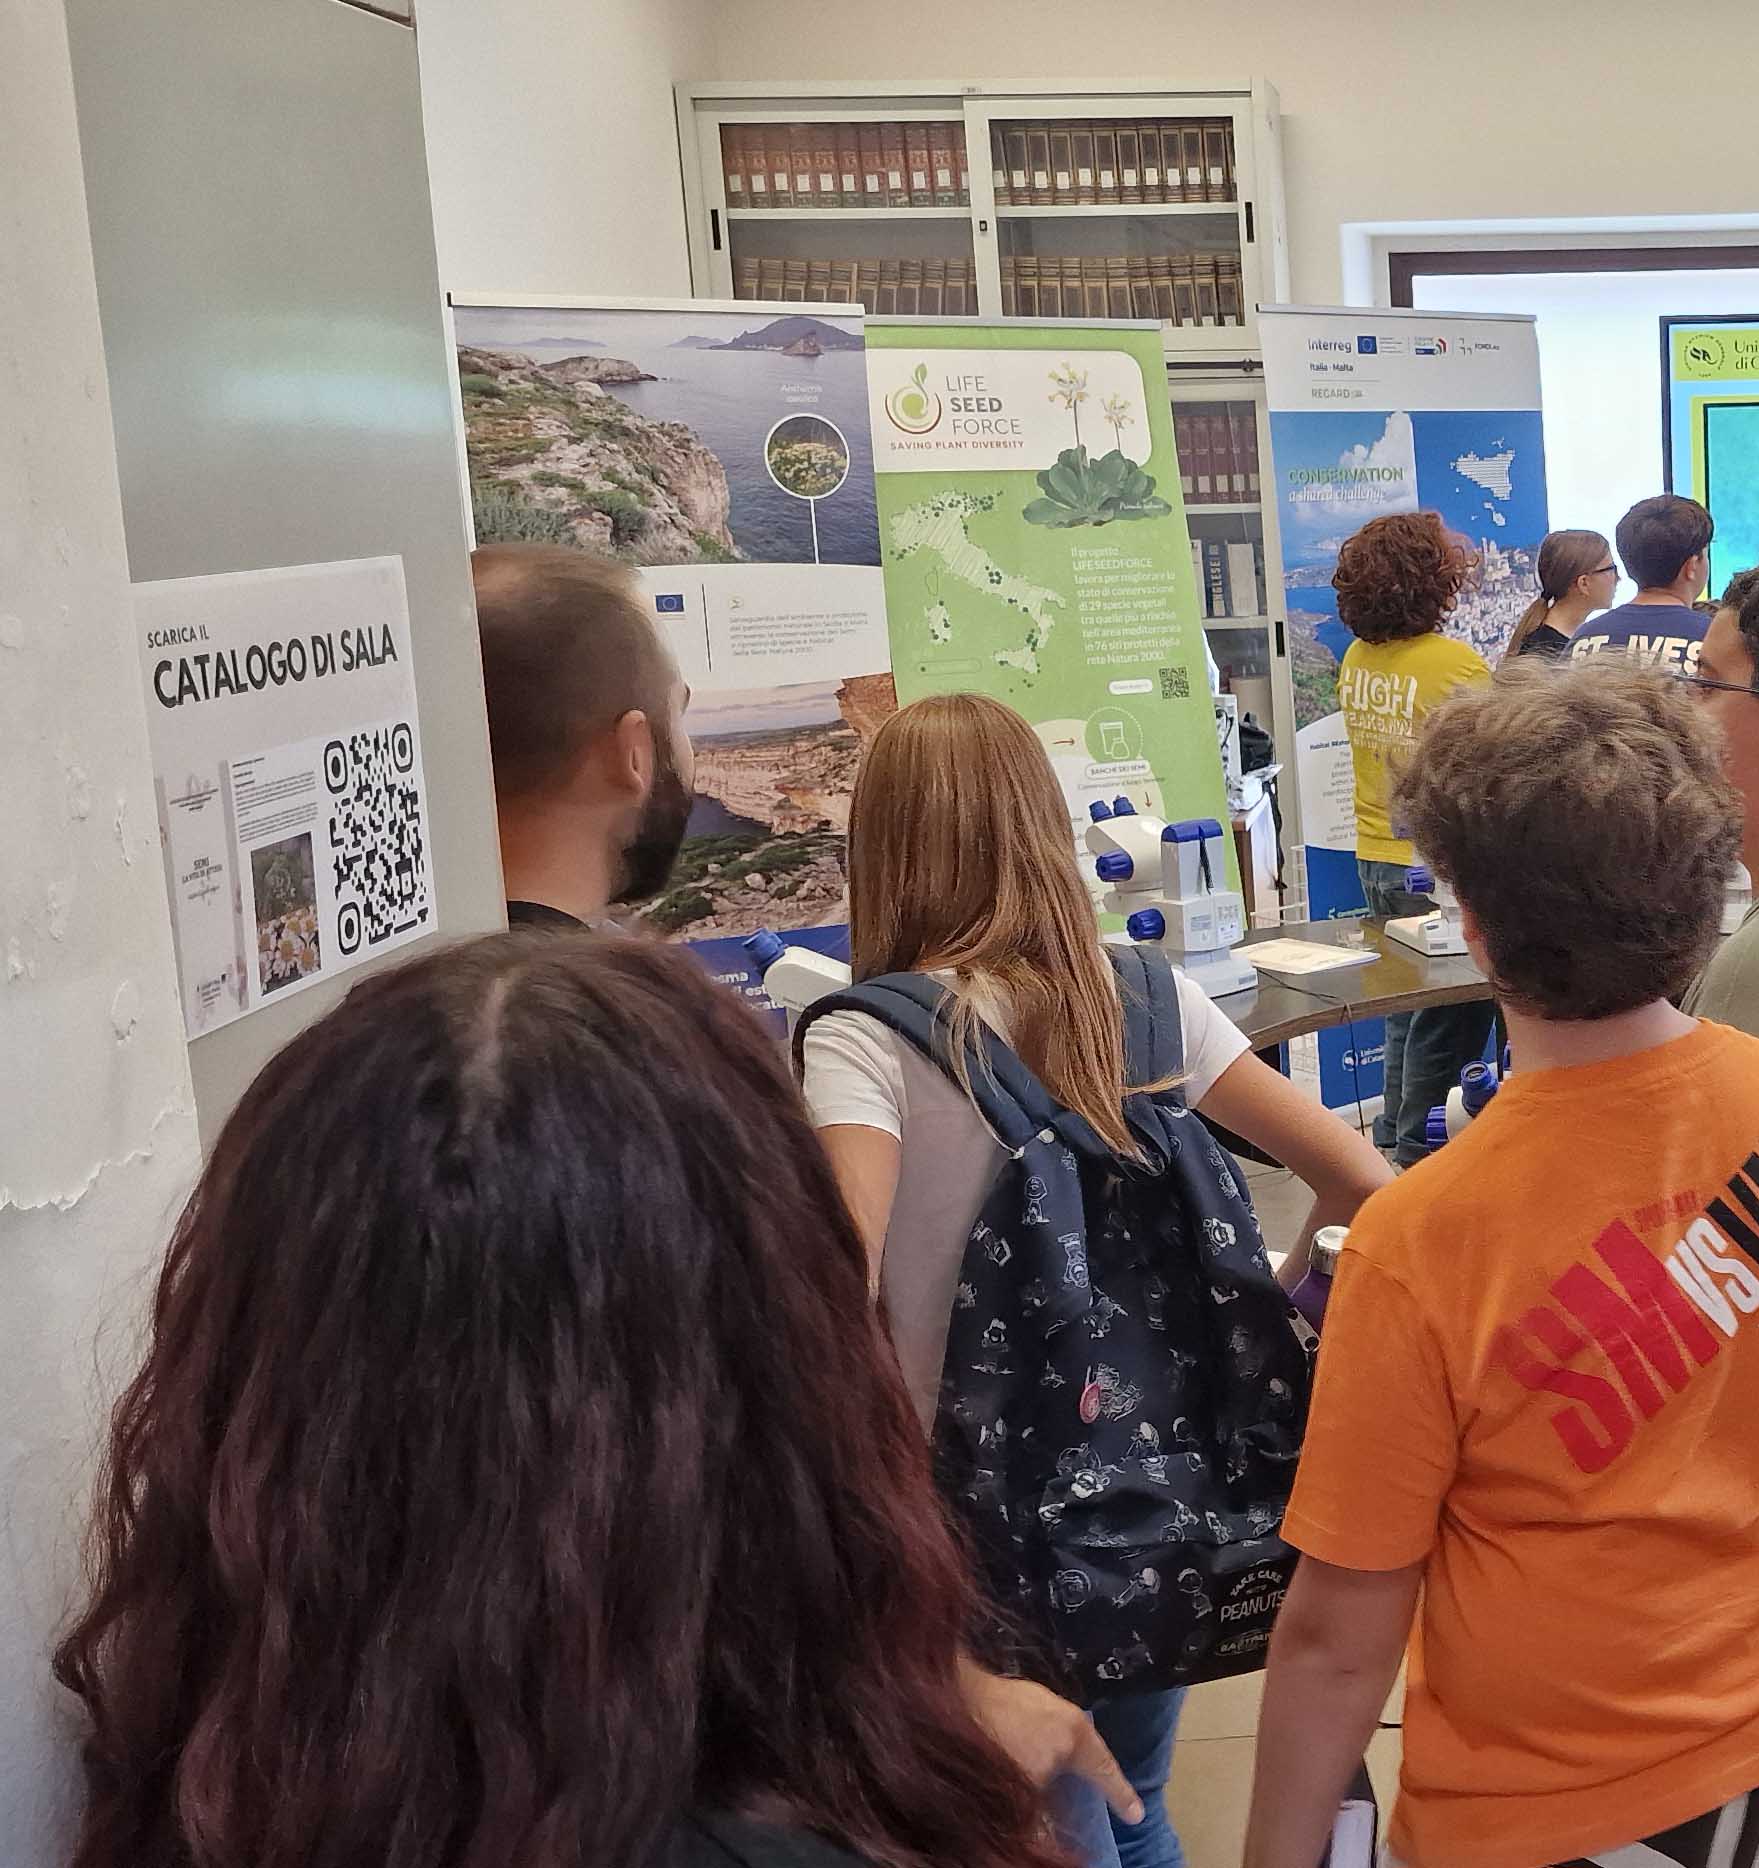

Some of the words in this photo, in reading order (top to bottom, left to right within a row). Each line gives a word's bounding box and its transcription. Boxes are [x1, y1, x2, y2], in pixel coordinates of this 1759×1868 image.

[1308, 338, 1352, 354] Interreg
[1310, 361, 1329, 372] Italia
[1332, 361, 1354, 372] Malta
[1735, 356, 1748, 370] di
[945, 375, 988, 392] LIFE
[950, 397, 1003, 413] SEED
[952, 418, 1023, 435] FORCE
[890, 441, 932, 451] SAVING
[936, 440, 968, 450] PLANT
[972, 440, 1024, 449] DIVERSITY
[1289, 467, 1405, 485] CONSERVATION
[147, 626, 198, 649] SCARICA
[199, 624, 210, 640] IL
[154, 638, 308, 709] CATALOGO
[311, 633, 337, 677] DI
[340, 623, 399, 672] SALA
[1341, 667, 1418, 719] HIGH
[1220, 1589, 1288, 1624] PEANUTS
